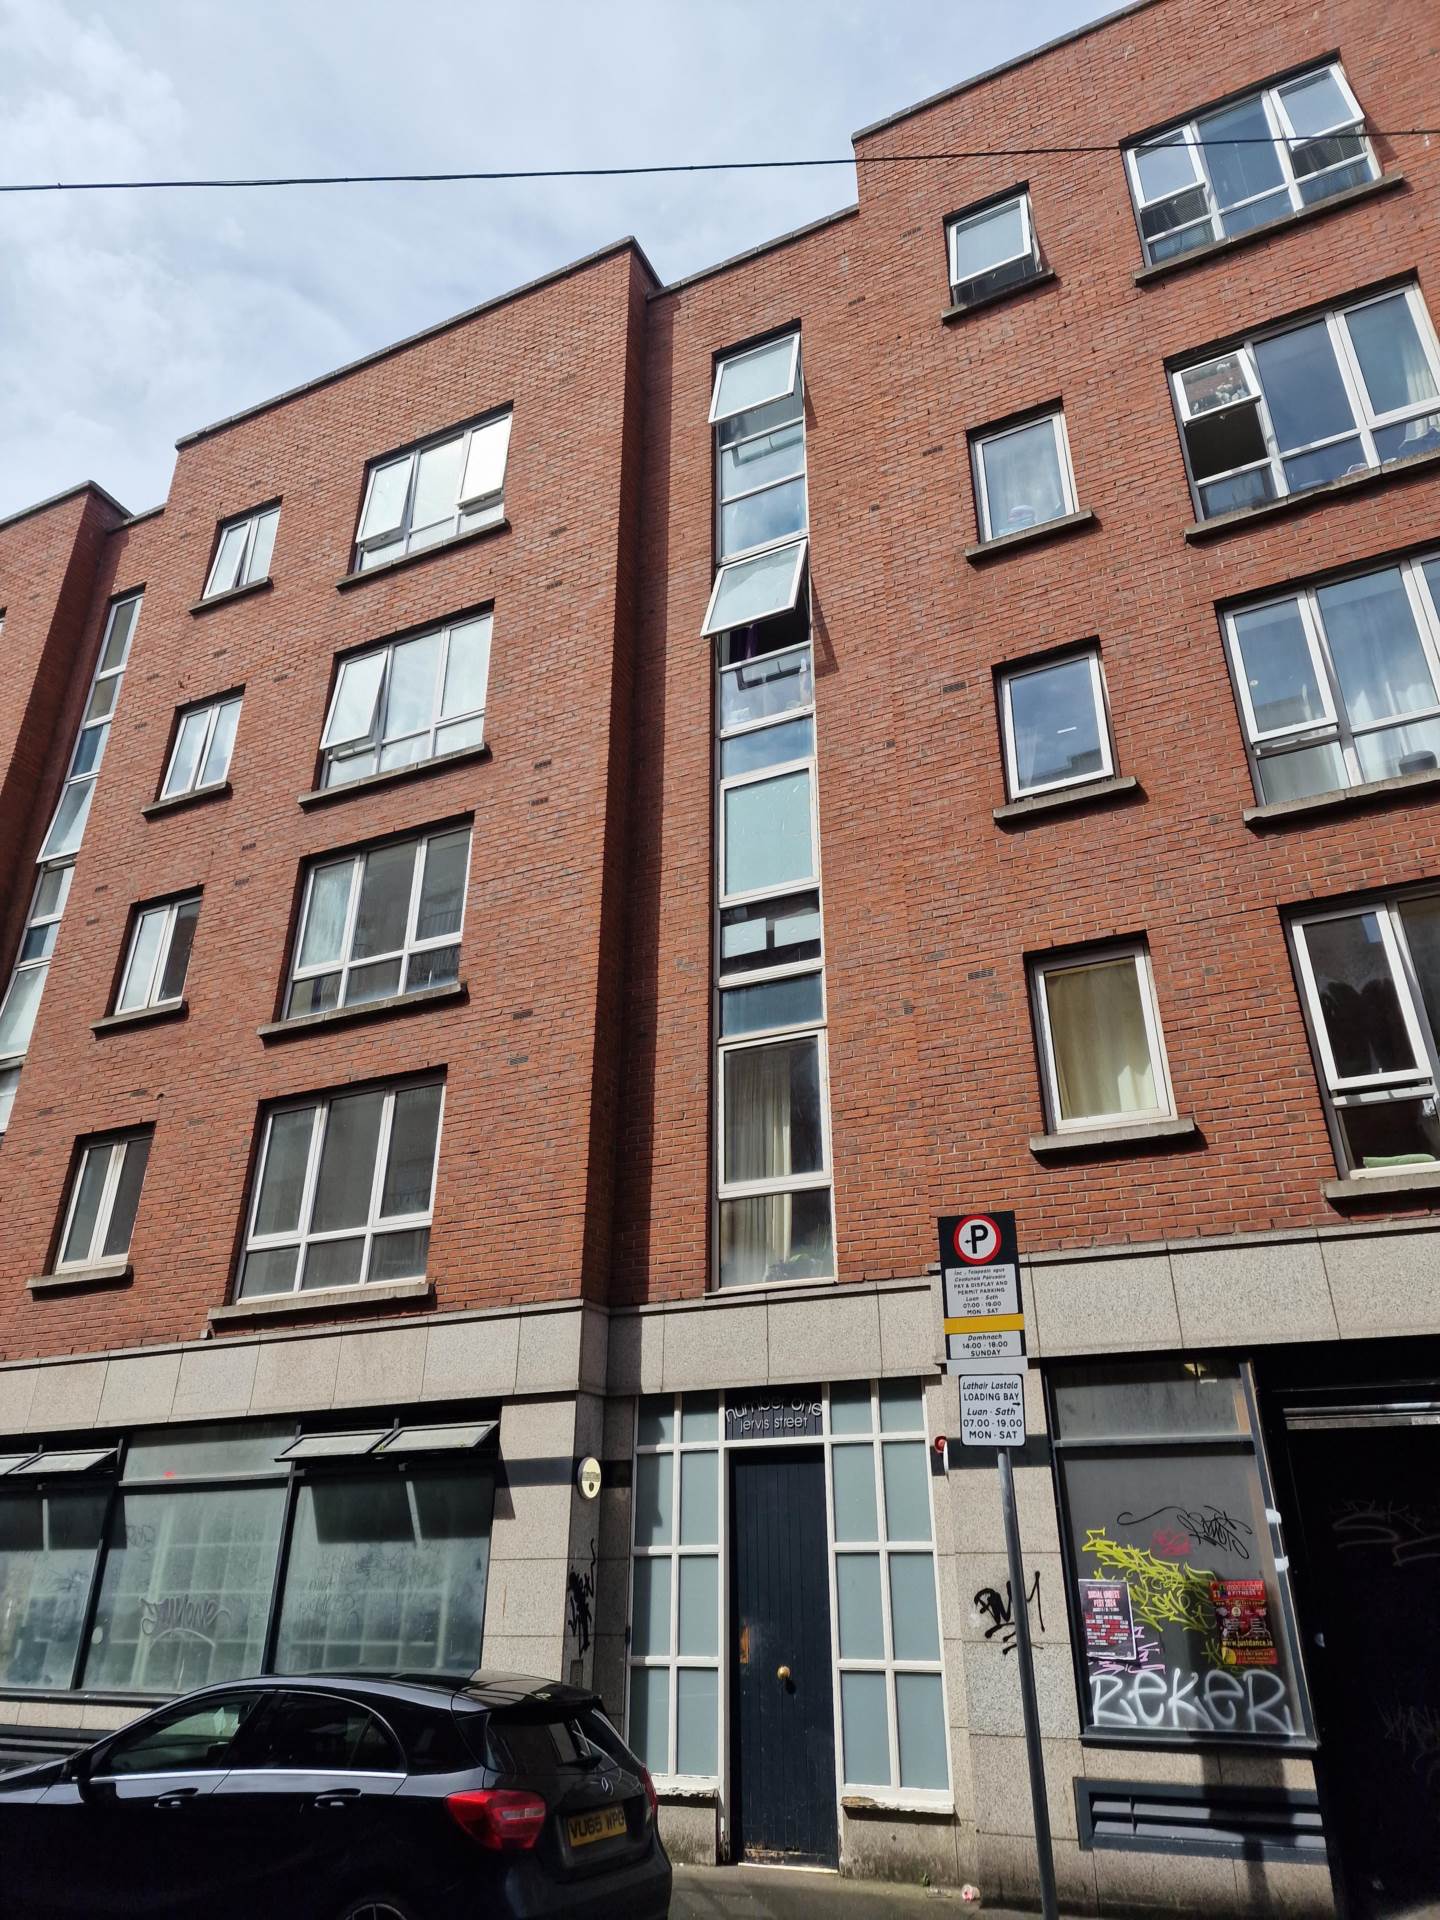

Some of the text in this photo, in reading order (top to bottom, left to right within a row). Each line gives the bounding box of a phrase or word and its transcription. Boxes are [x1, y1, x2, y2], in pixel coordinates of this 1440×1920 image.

[971, 1224, 988, 1254] P
[968, 1333, 1002, 1341] Domhnach
[964, 1392, 1019, 1401] LOADING BAY
[791, 1398, 822, 1416] one
[967, 1408, 988, 1416] Luan
[995, 1407, 1016, 1416] Sath
[740, 1415, 808, 1433] jervis street
[963, 1419, 990, 1427] 07.00
[997, 1419, 1022, 1427] 19.00
[969, 1431, 992, 1439] MON
[999, 1431, 1017, 1439] SAT
